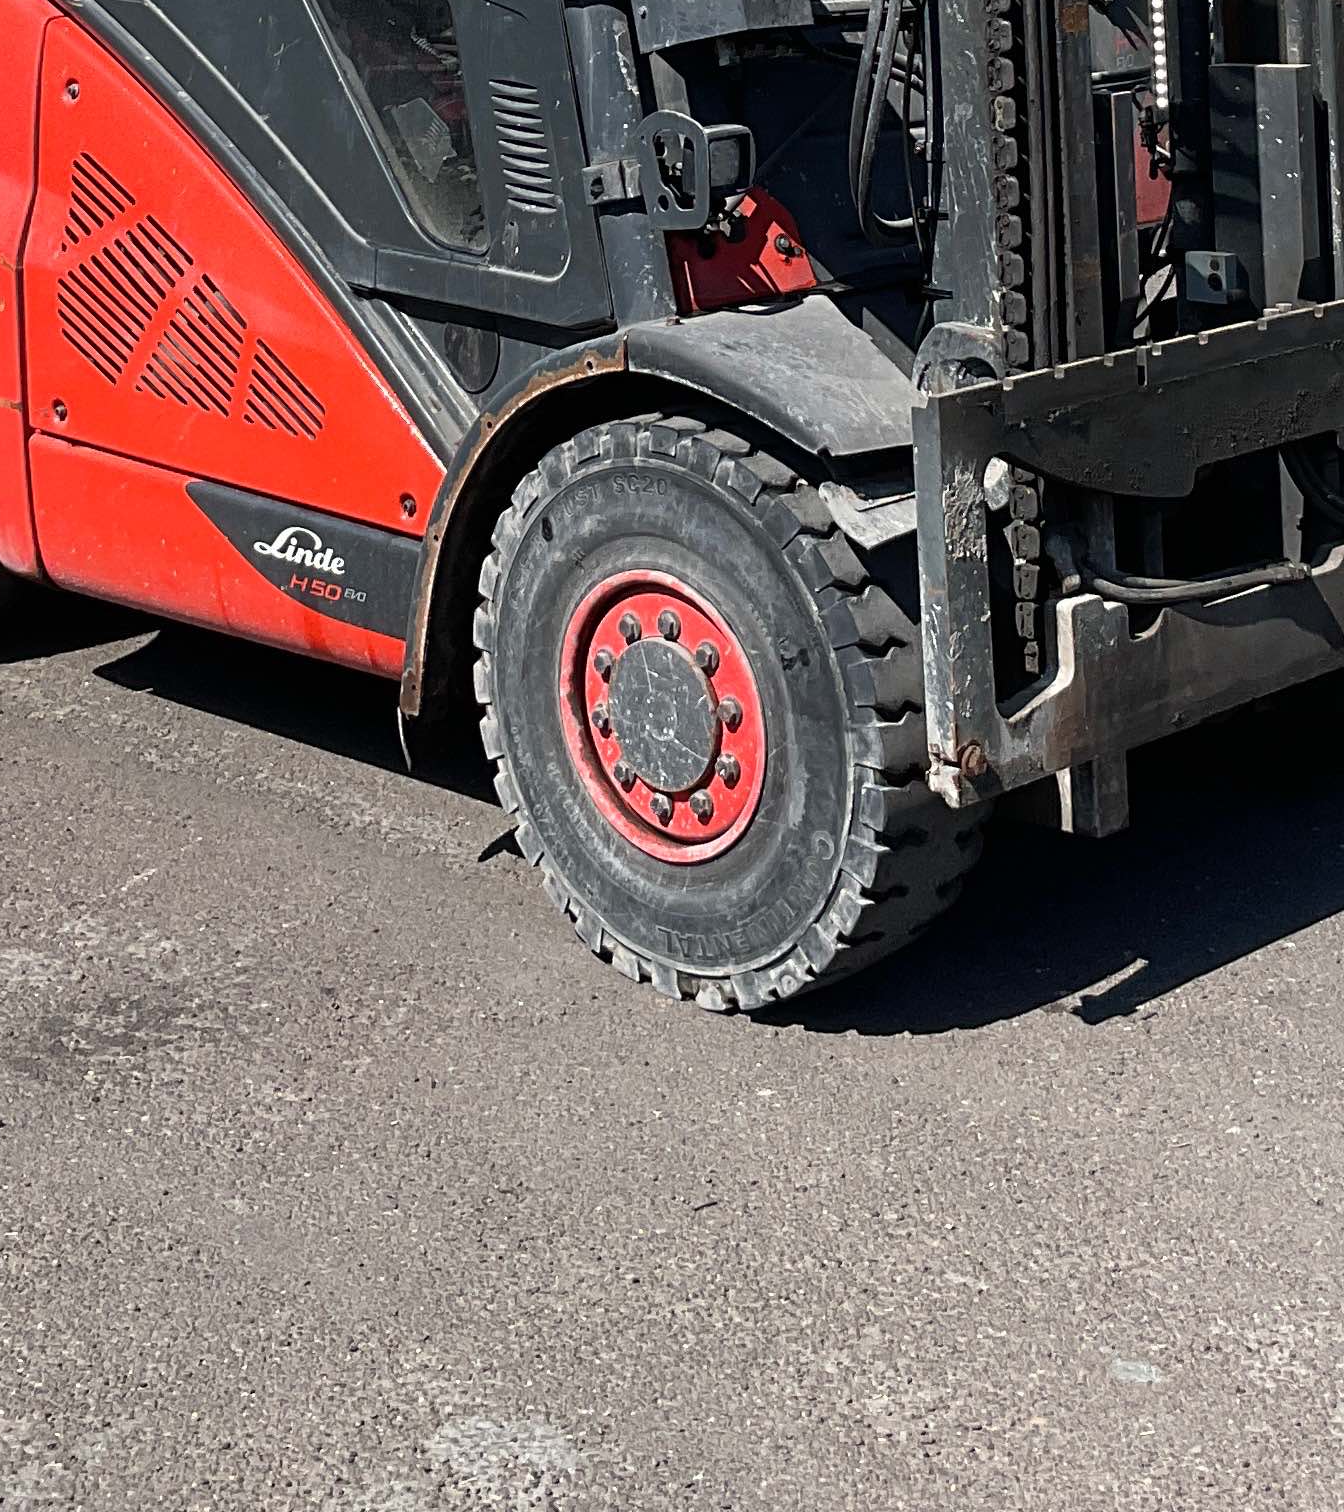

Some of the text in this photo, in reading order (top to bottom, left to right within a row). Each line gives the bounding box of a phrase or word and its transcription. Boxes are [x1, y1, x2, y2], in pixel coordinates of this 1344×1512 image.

[612, 472, 669, 496] SC20
[253, 526, 346, 575] Linde
[655, 829, 836, 962] CONTINENTAL
